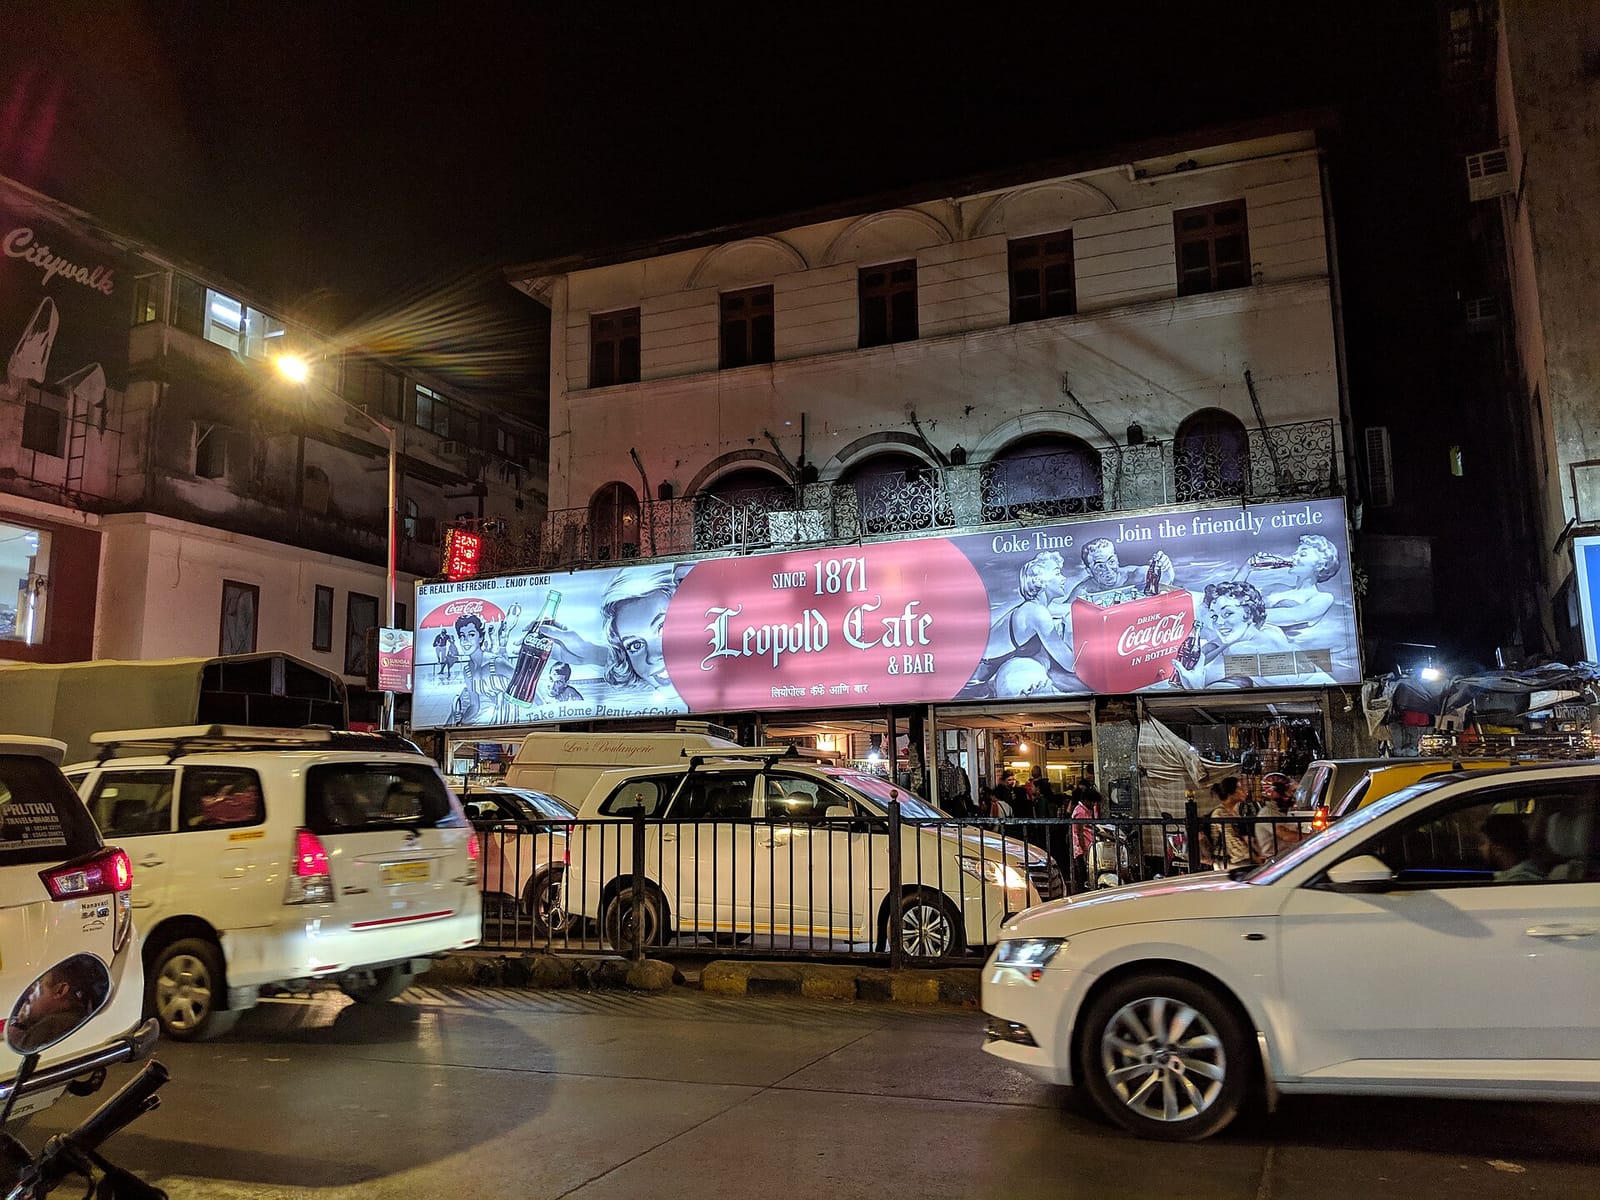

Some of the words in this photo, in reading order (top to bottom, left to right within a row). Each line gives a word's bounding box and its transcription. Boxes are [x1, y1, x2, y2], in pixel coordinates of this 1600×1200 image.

[2, 228, 114, 295] Citywalk
[1116, 524, 1152, 543] Join
[1158, 519, 1186, 538] the
[1191, 512, 1265, 536] friendly
[1271, 506, 1323, 528] circle
[992, 534, 1030, 554] Coke
[1031, 531, 1074, 550] Time
[419, 586, 428, 595] BE
[429, 583, 455, 595] REALLY
[505, 577, 528, 588] ENJOY
[529, 575, 551, 586] COKE!
[772, 571, 807, 589] SINCE
[813, 556, 868, 595] 1871
[1137, 613, 1161, 625] DRINK
[700, 603, 829, 671] Leopold
[843, 594, 933, 651] Cafe
[887, 655, 899, 675] &
[902, 653, 935, 675] BAR
[1131, 656, 1142, 666] IN
[1144, 646, 1178, 662] BOTTLES
[771, 685, 807, 698] लियोपोल्ड
[828, 682, 851, 695] आणि
[853, 683, 869, 694] बार
[526, 709, 555, 722] Take
[558, 706, 592, 718] Home
[592, 740, 656, 757] Boulangerie
[3, 802, 56, 816] PRUTHVI
